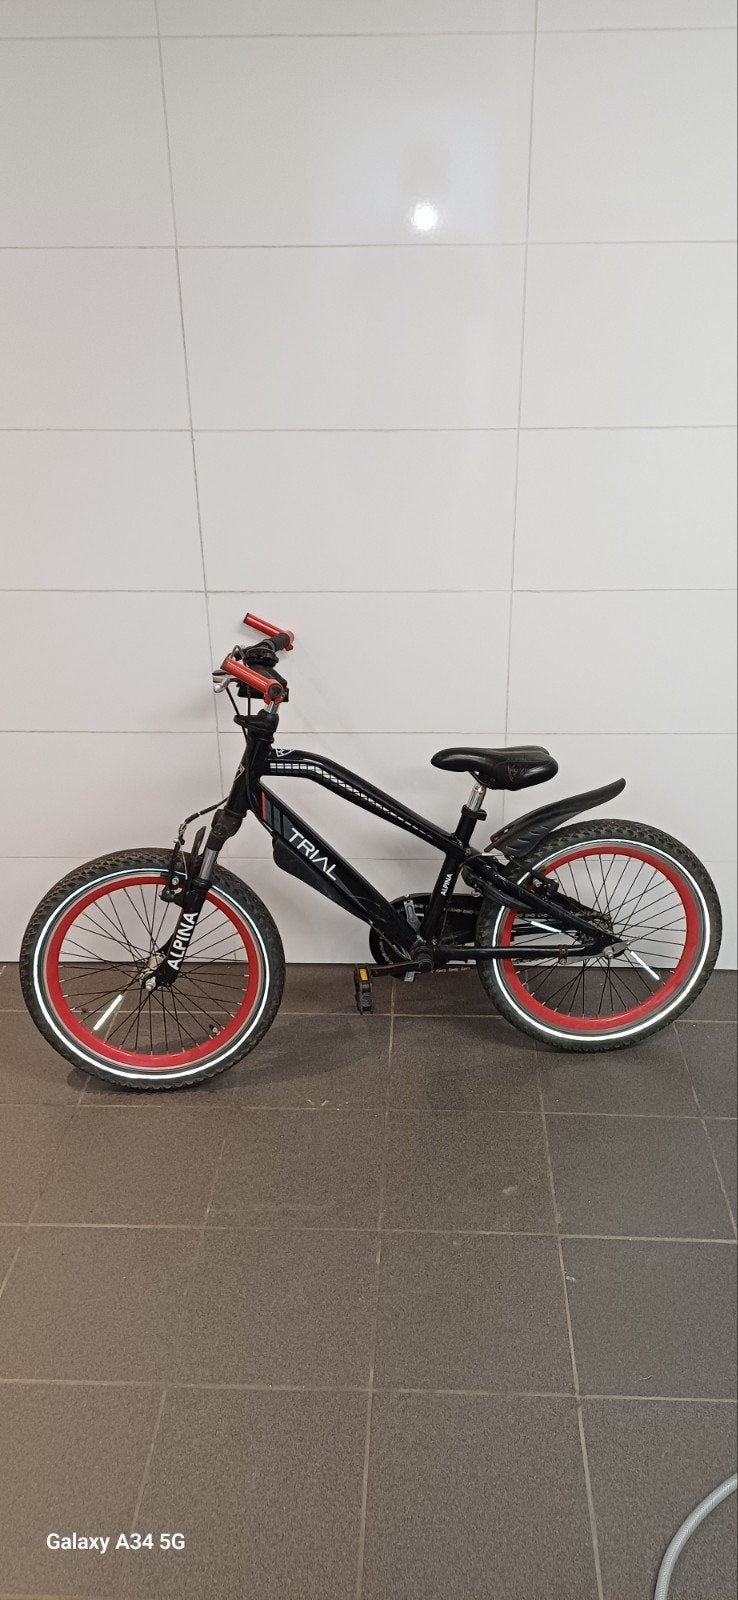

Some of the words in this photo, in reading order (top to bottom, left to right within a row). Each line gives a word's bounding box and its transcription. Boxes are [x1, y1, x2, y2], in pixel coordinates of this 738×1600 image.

[288, 827, 337, 881] TRIAL
[440, 873, 454, 897] ALPINA
[167, 912, 199, 971] ALPINA
